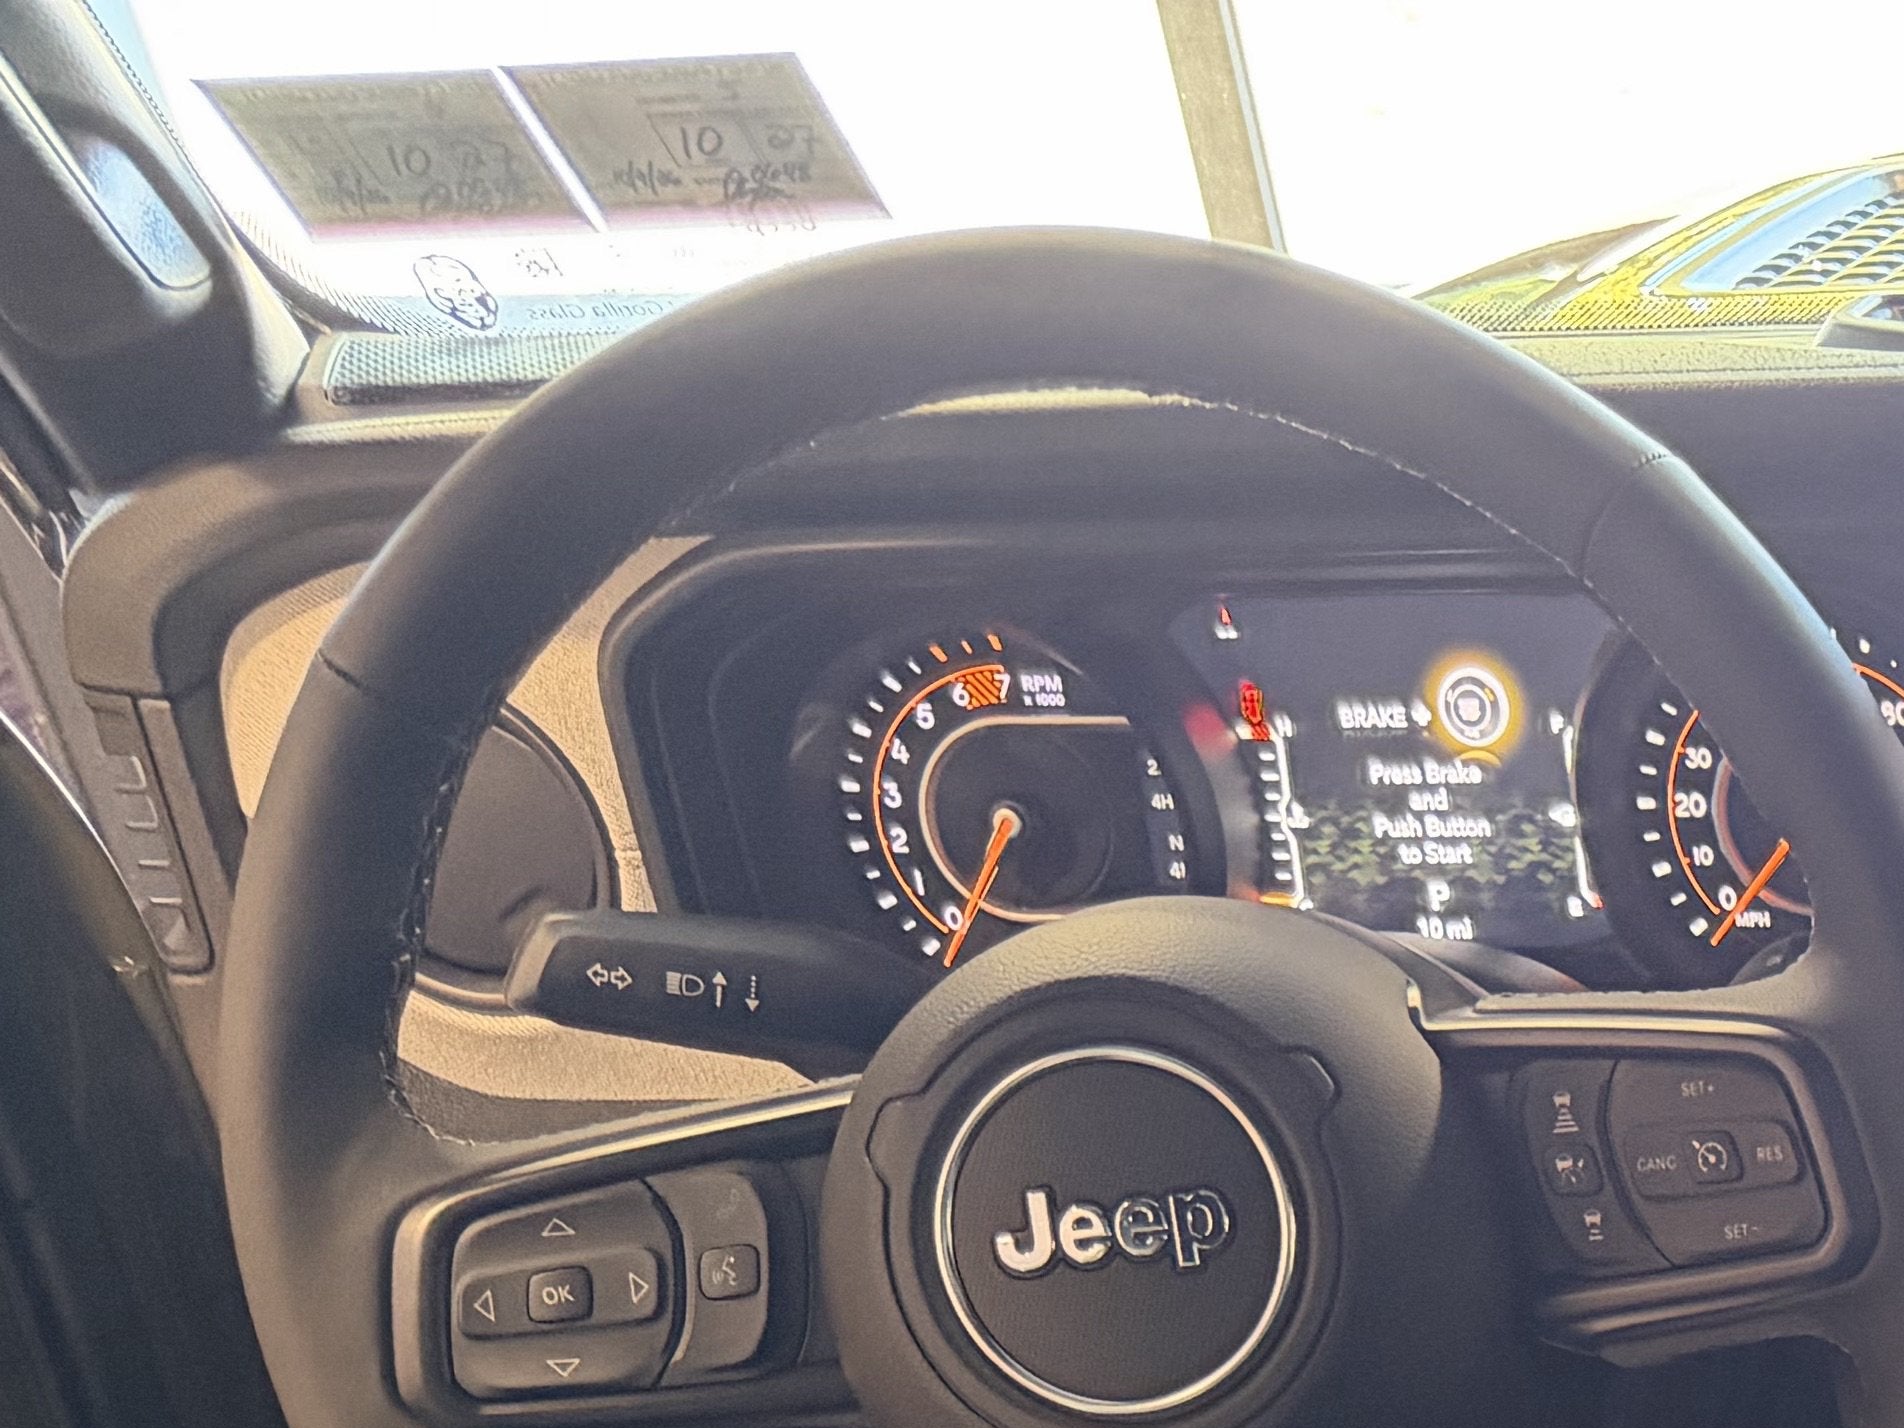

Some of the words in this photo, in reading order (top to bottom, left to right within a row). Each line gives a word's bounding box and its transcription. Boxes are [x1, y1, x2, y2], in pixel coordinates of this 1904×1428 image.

[952, 683, 971, 707] 6
[992, 673, 1012, 702] 7
[1019, 673, 1064, 693] RPM
[1035, 694, 1067, 708] 1000
[915, 702, 936, 731] 5
[1339, 706, 1408, 730] BRAKE
[890, 738, 911, 765] 4
[1684, 747, 1713, 770] 30
[1368, 761, 1424, 785] Press
[1426, 760, 1483, 785] Brake
[883, 782, 903, 810] 3
[1151, 792, 1176, 811] 4H
[1408, 788, 1450, 811] and
[1674, 792, 1709, 818] 20
[1373, 814, 1423, 839] Push
[1426, 815, 1493, 839] Button
[888, 827, 911, 855] 2
[1400, 845, 1422, 866] to
[1423, 843, 1474, 867] Start
[1692, 844, 1714, 867] 10
[913, 869, 926, 897] 1
[1427, 880, 1451, 912] P
[1717, 884, 1738, 911] 0
[943, 904, 965, 932] 0
[1415, 916, 1446, 941] 10
[1735, 910, 1772, 929] MPH
[1636, 1155, 1677, 1172] CANC
[1756, 1145, 1784, 1162] RES
[994, 1187, 1231, 1274] Jeep
[540, 1282, 576, 1306] OK
